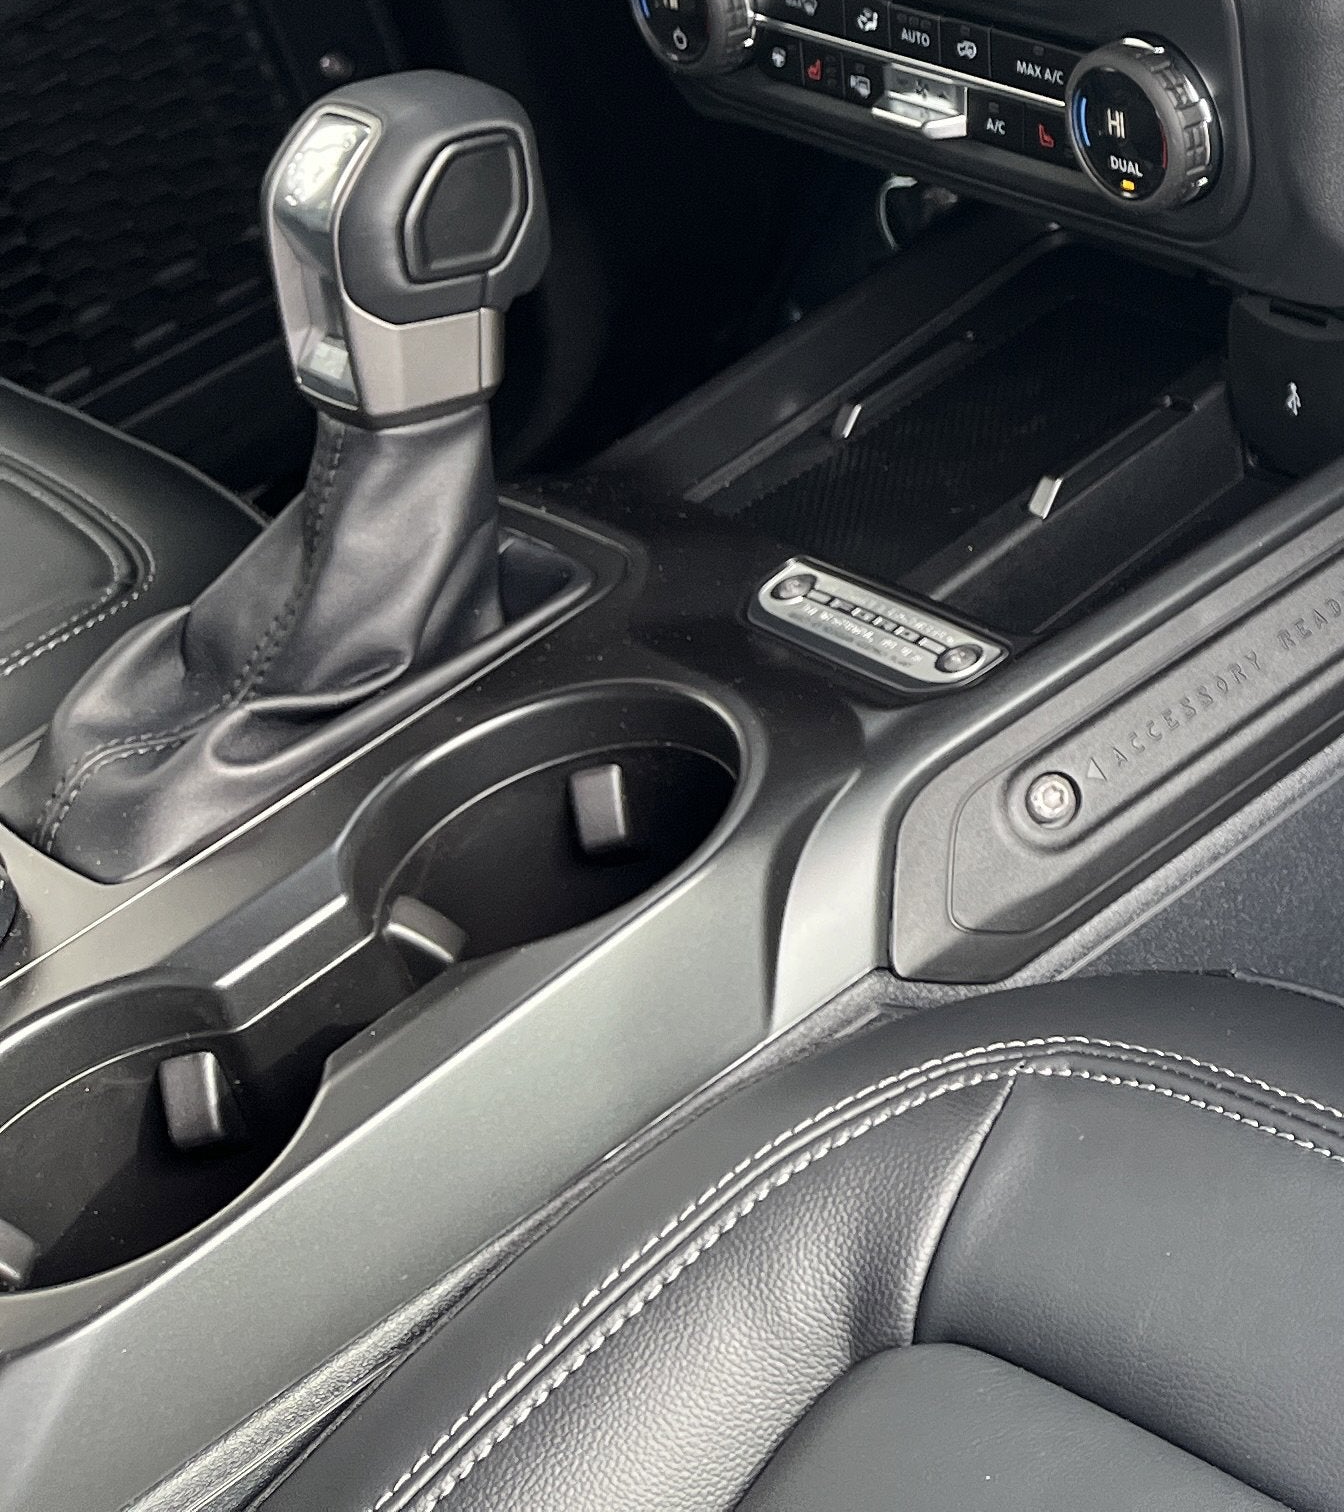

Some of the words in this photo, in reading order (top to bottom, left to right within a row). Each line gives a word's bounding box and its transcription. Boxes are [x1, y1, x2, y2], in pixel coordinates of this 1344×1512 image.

[901, 27, 930, 47] AUTO
[1016, 60, 1042, 80] MAX
[1043, 67, 1064, 85] A/C
[986, 117, 1006, 136] A/C
[1107, 107, 1126, 139] HI
[1110, 155, 1143, 178] DUAL
[1112, 649, 1261, 768] ACCESSORY
